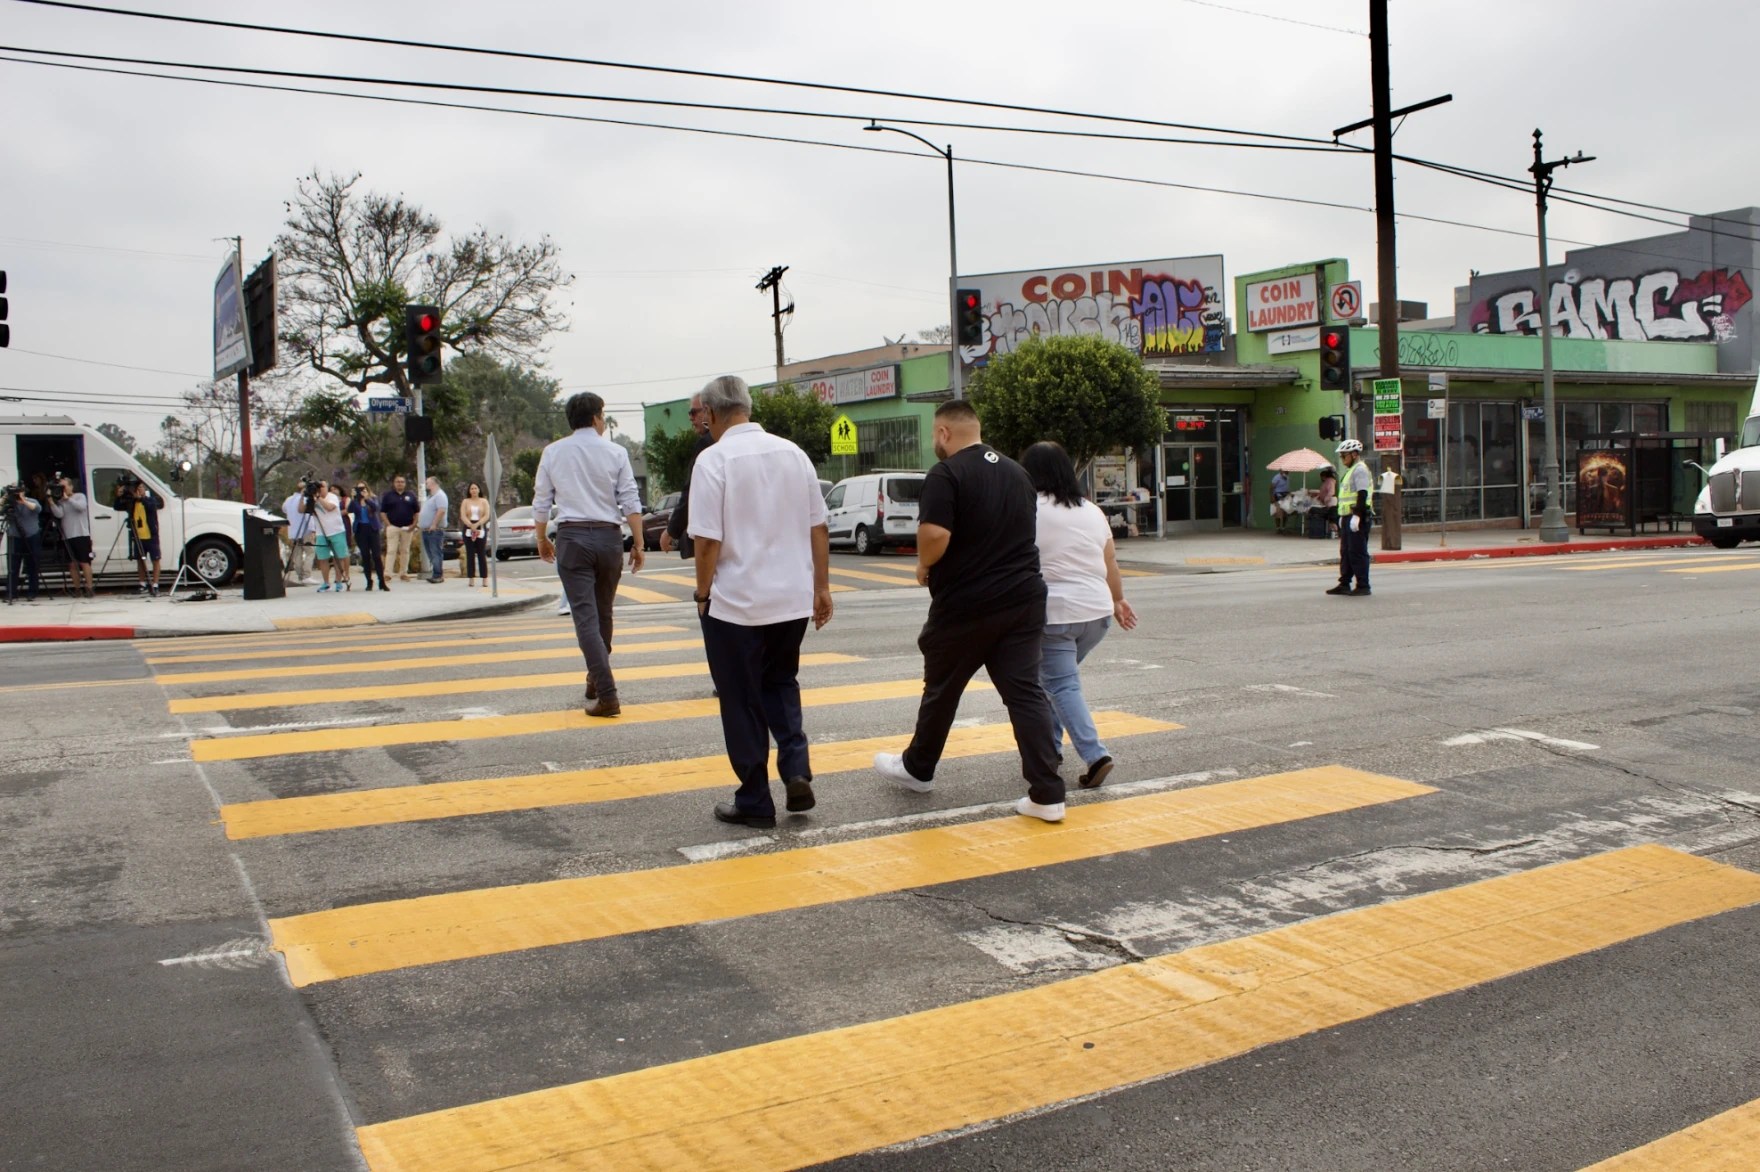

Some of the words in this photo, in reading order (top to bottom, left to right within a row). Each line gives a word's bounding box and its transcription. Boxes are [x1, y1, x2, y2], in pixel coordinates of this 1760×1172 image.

[1022, 268, 1142, 303] COIN
[1260, 281, 1301, 303] COIN
[1249, 301, 1315, 328] LAUNDRY
[870, 369, 889, 383] COIN
[866, 383, 895, 397] LAUNDRY
[371, 399, 399, 408] Olympic
